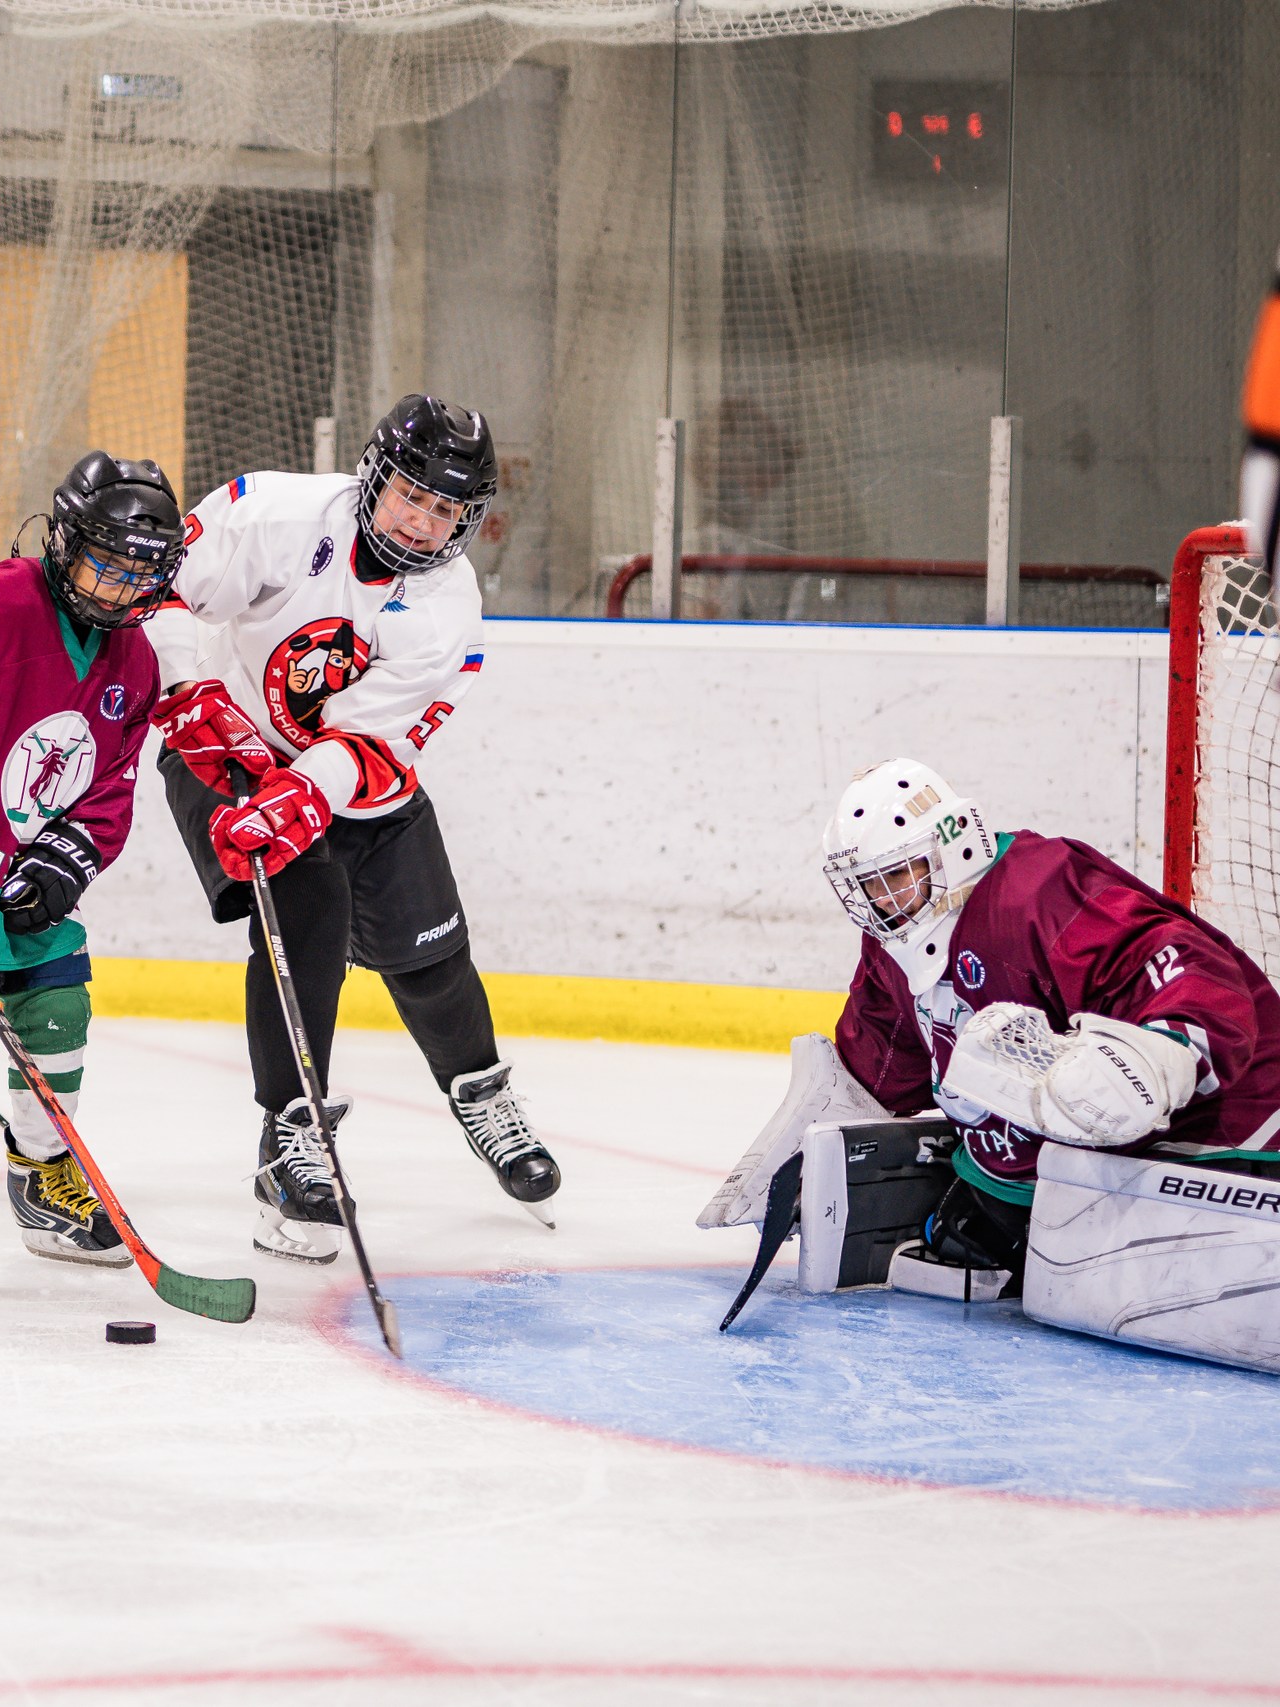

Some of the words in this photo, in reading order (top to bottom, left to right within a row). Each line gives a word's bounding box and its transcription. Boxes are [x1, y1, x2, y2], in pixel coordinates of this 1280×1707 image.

[445, 468, 469, 480] PRIME
[125, 534, 168, 549] BAUER
[158, 703, 203, 739] CM
[268, 687, 311, 747] БАНДА
[243, 826, 266, 839] CCM
[935, 814, 963, 847] 12
[970, 808, 994, 859] BAUER
[35, 831, 98, 882] BAUE
[827, 846, 859, 861] BAUER
[415, 911, 460, 947] PRIME
[271, 934, 290, 977] BAUER
[1144, 945, 1185, 990] 12
[1097, 1045, 1155, 1106] BAUER
[1159, 1175, 1280, 1214] BAUER
